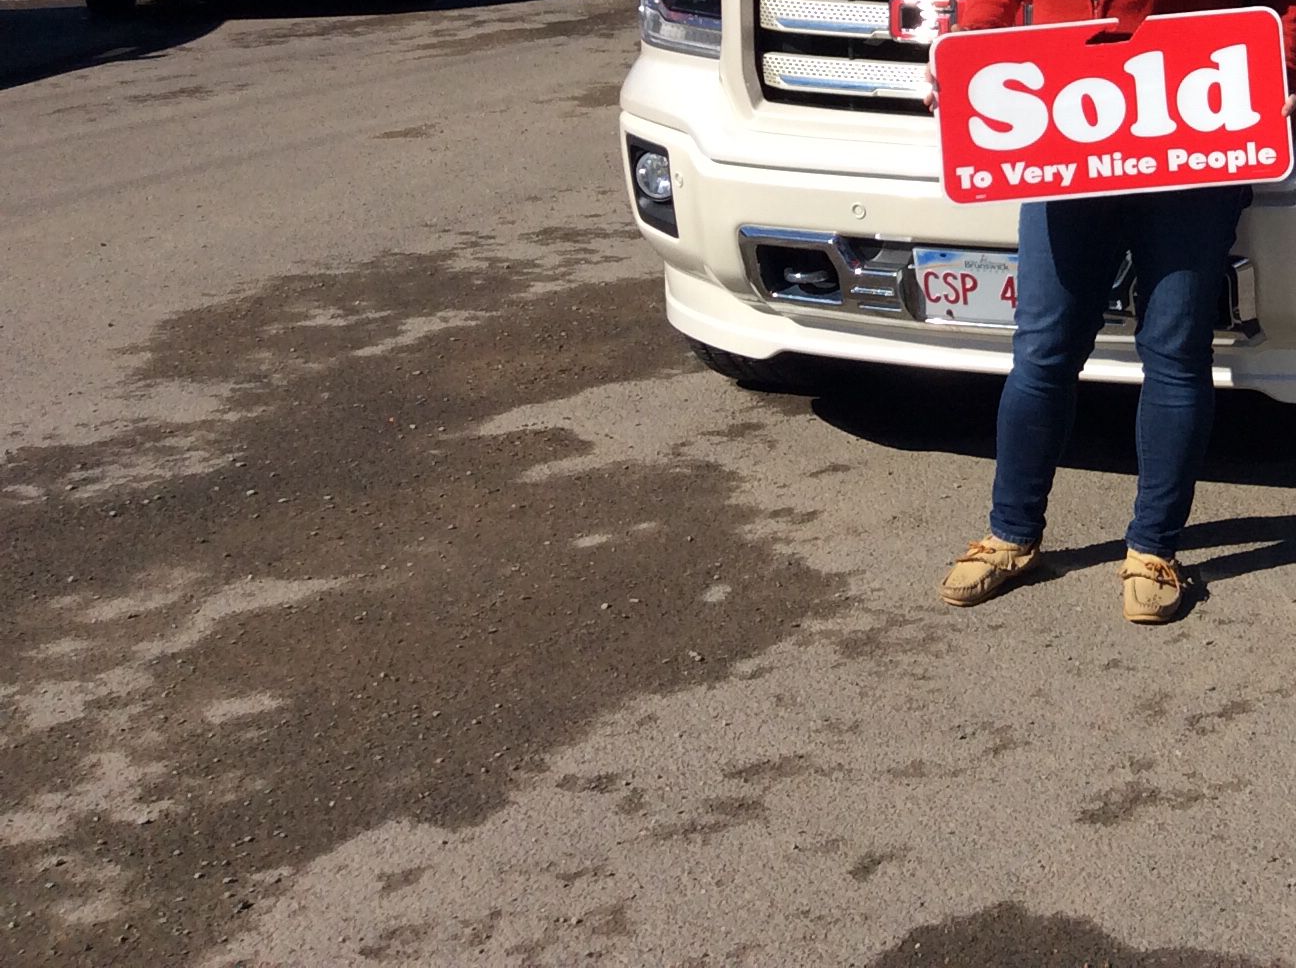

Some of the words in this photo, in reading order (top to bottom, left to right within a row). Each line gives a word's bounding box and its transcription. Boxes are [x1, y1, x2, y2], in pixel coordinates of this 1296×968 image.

[967, 44, 1261, 151] Sold
[956, 166, 993, 190] To
[1001, 161, 1077, 187] Very
[1087, 151, 1157, 179] Nice
[1167, 141, 1277, 173] People
[924, 271, 978, 305] CSP
[1001, 276, 1017, 309] 4
